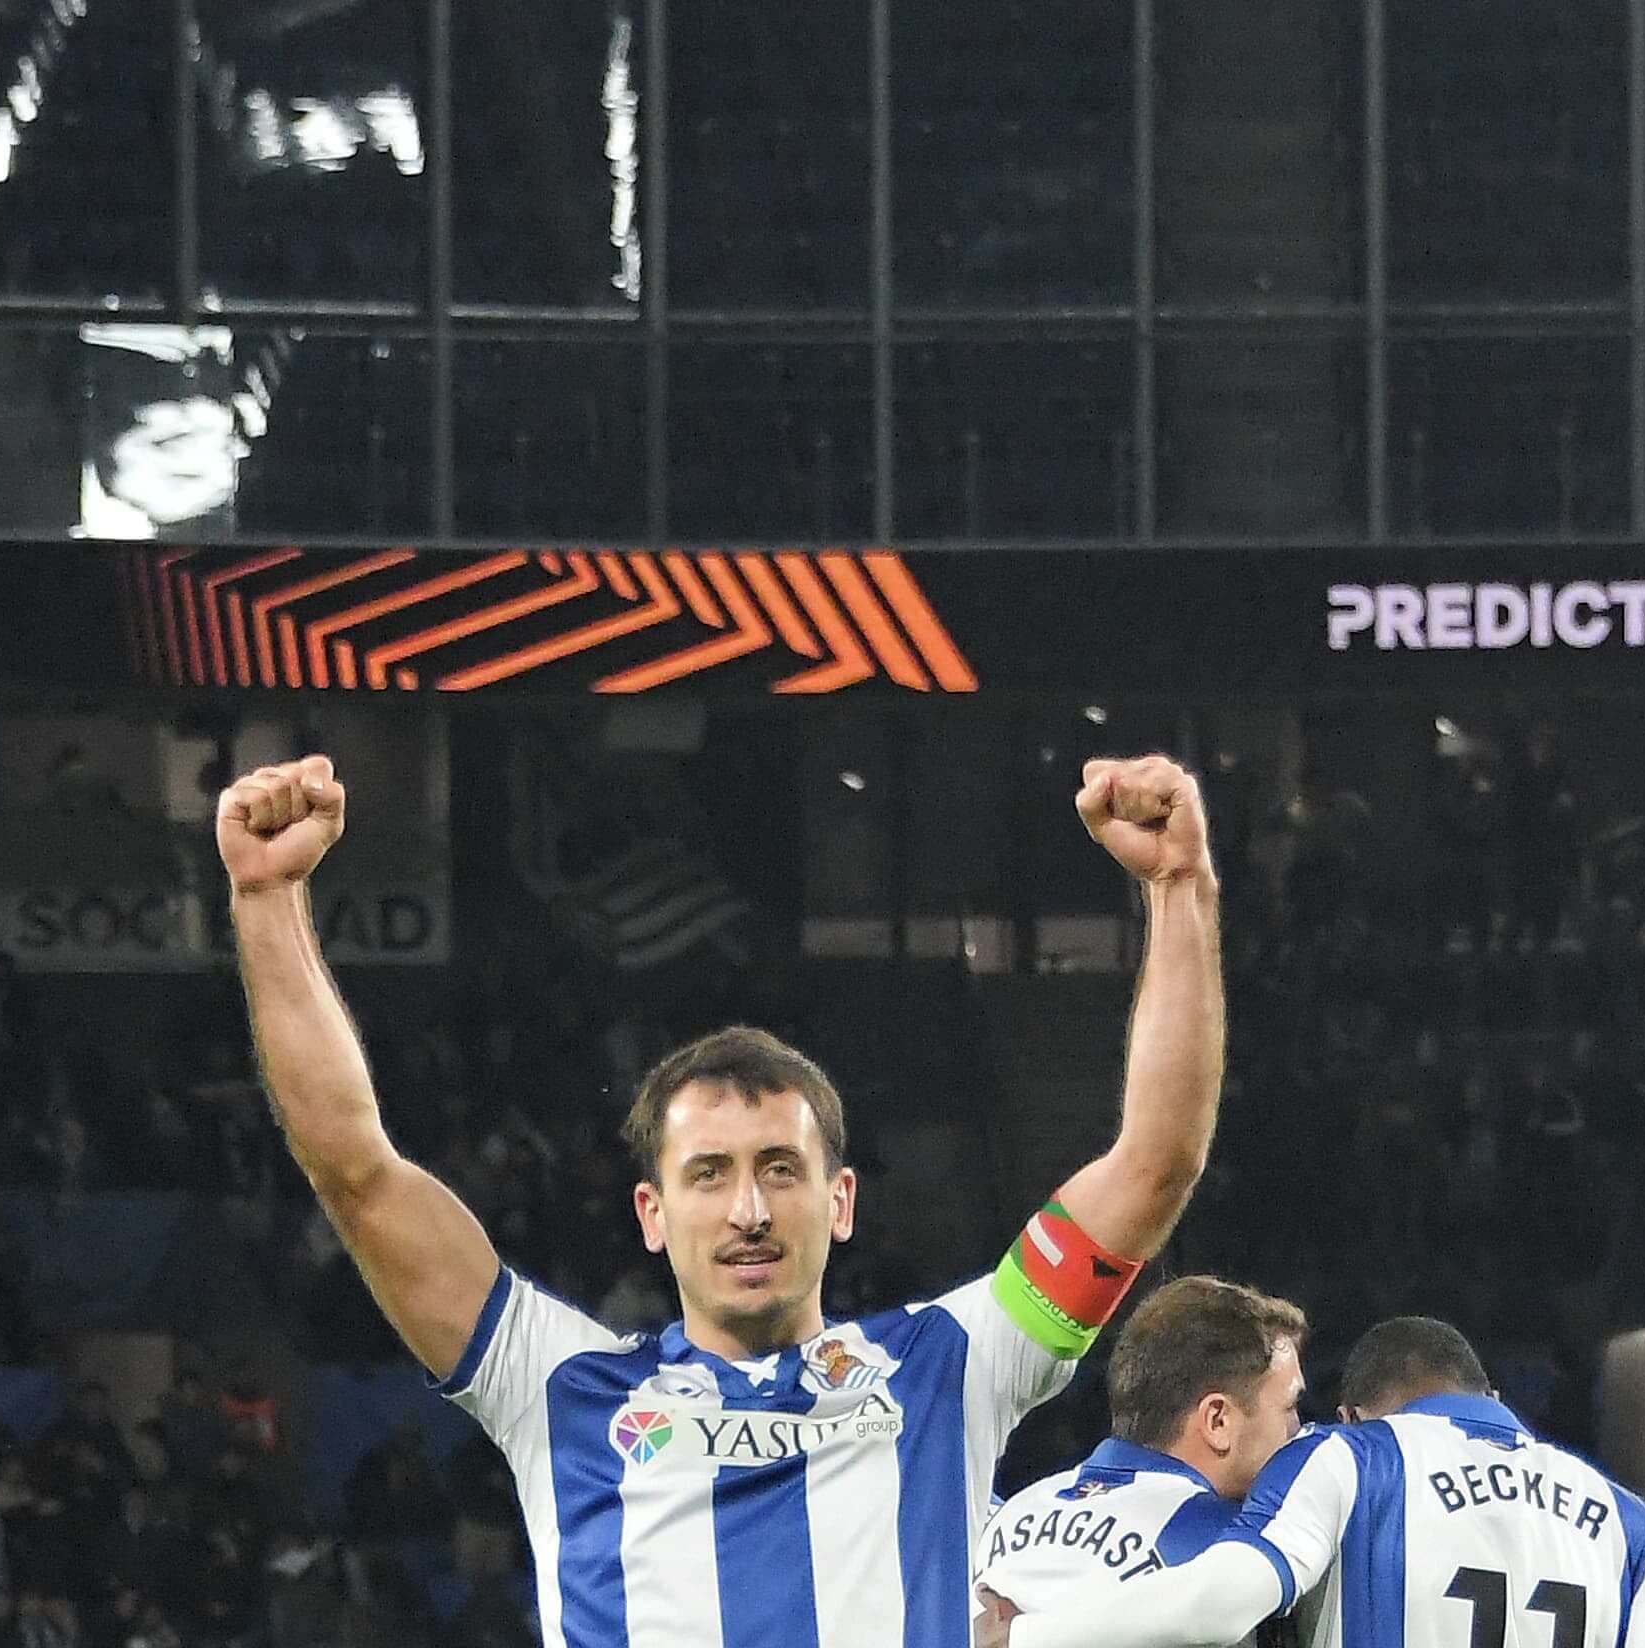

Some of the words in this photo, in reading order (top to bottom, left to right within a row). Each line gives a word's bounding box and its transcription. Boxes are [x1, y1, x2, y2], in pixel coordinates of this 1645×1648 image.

[691, 1393, 896, 1460] YASUA
[856, 1420, 899, 1438] group
[1428, 1463, 1609, 1541] BECKER
